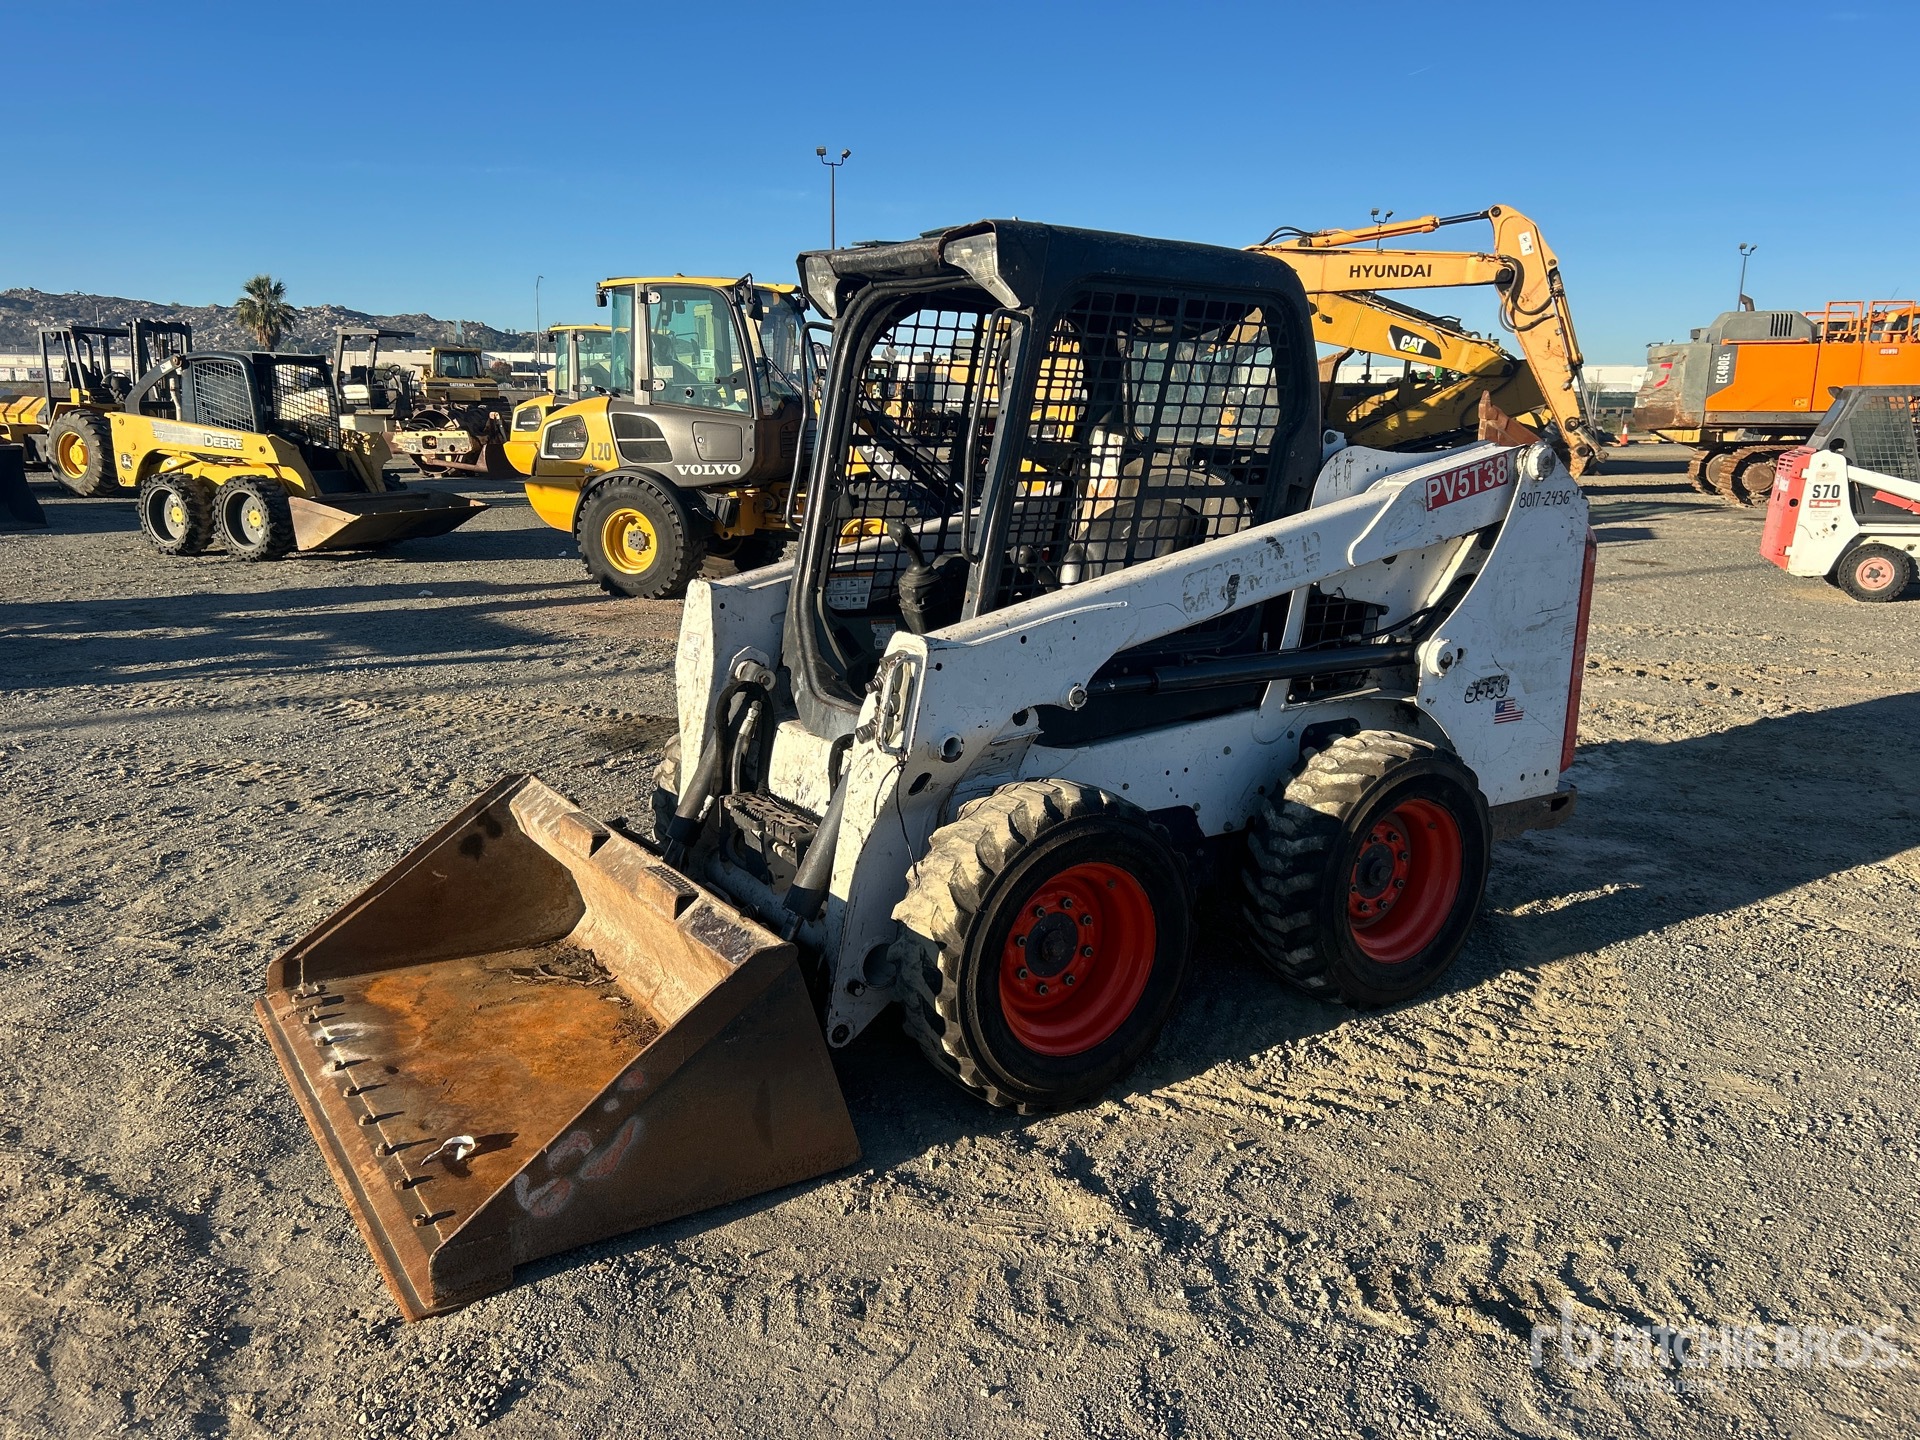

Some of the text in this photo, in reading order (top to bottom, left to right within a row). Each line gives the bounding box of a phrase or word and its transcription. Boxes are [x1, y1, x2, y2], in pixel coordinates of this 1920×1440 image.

[1349, 264, 1432, 278] HYUNDAI
[1400, 335, 1427, 354] CAT
[203, 433, 243, 450] DEERE
[591, 442, 612, 461] L20
[675, 464, 741, 476] VOLVO
[1427, 456, 1508, 509] PV5T38
[1518, 490, 1571, 508] 8017-2436
[1812, 485, 1841, 498] S70
